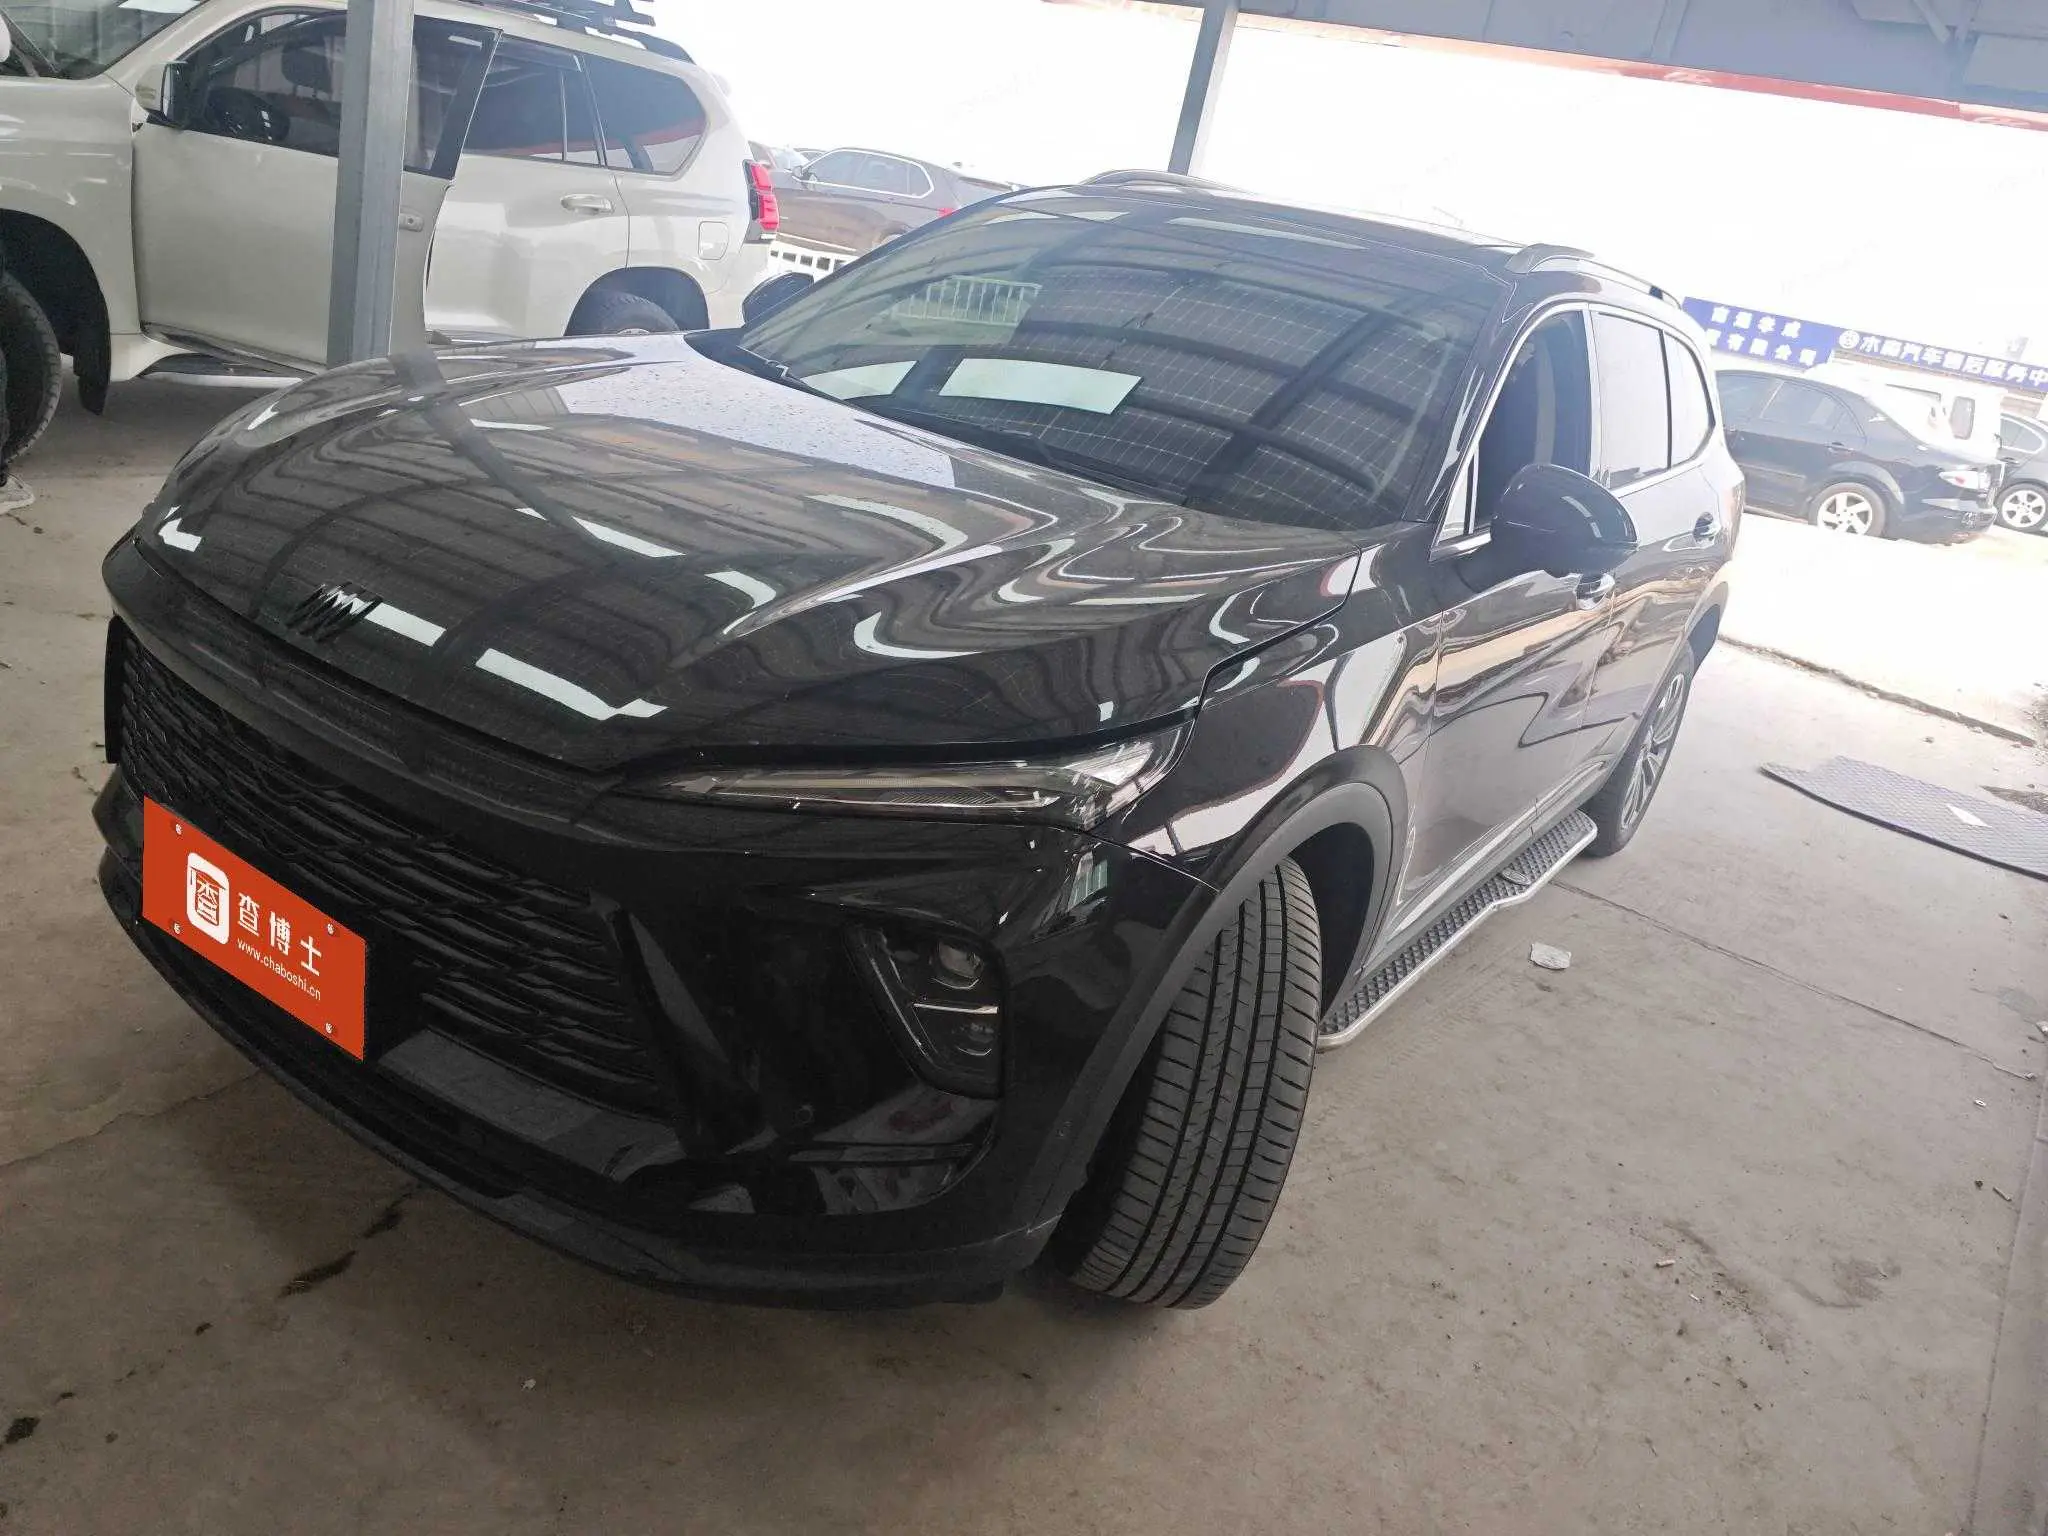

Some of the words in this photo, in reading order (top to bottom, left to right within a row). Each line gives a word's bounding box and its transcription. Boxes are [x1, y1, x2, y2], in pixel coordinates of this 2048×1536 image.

[236, 937, 322, 1001] www.chaboshi.cn
[237, 891, 322, 977] 查博士
